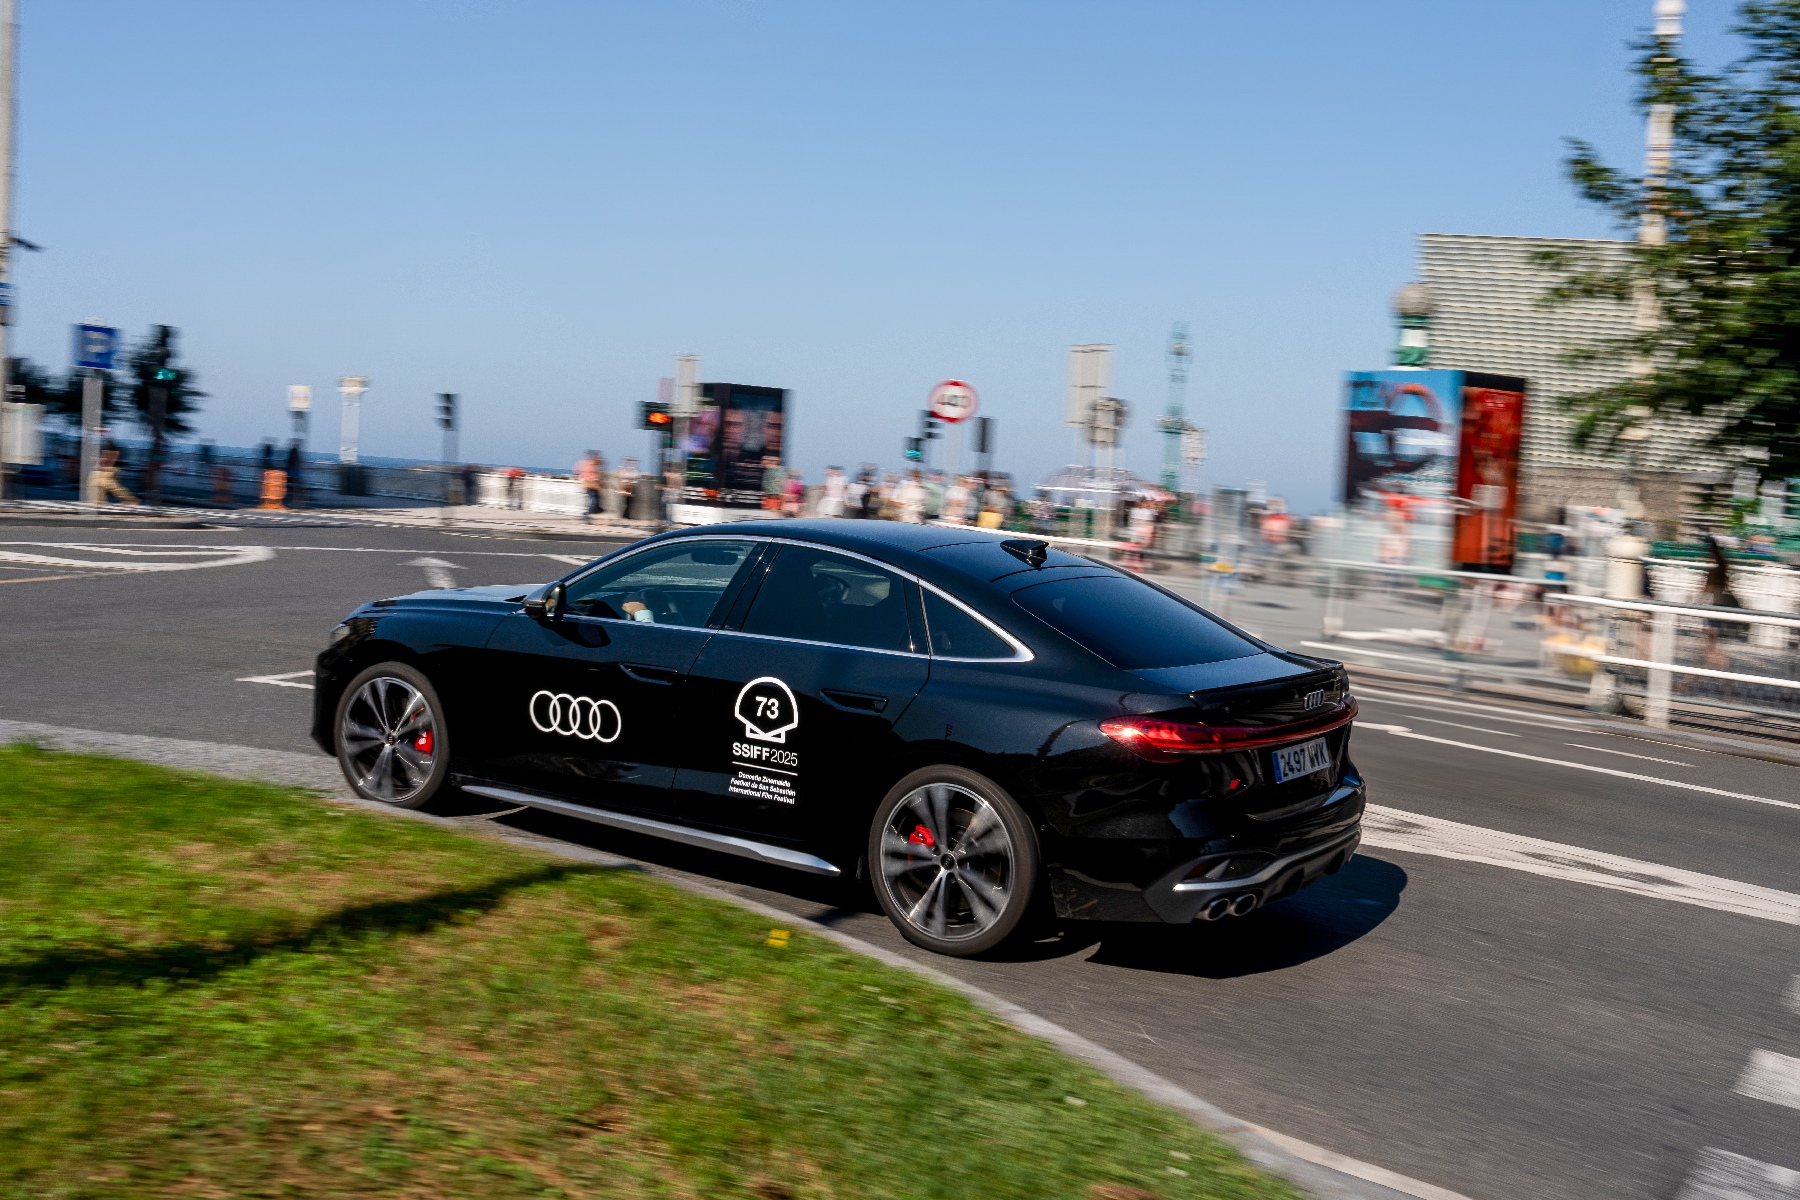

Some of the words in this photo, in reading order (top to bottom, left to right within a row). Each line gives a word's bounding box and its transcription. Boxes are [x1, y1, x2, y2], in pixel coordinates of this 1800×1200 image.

[755, 695, 779, 719] 73
[1280, 748, 1306, 778] 2497
[728, 785, 762, 798] International
[761, 791, 773, 800] Film
[773, 794, 795, 805] Festival
[730, 777, 751, 788] Festival
[758, 783, 769, 791] San
